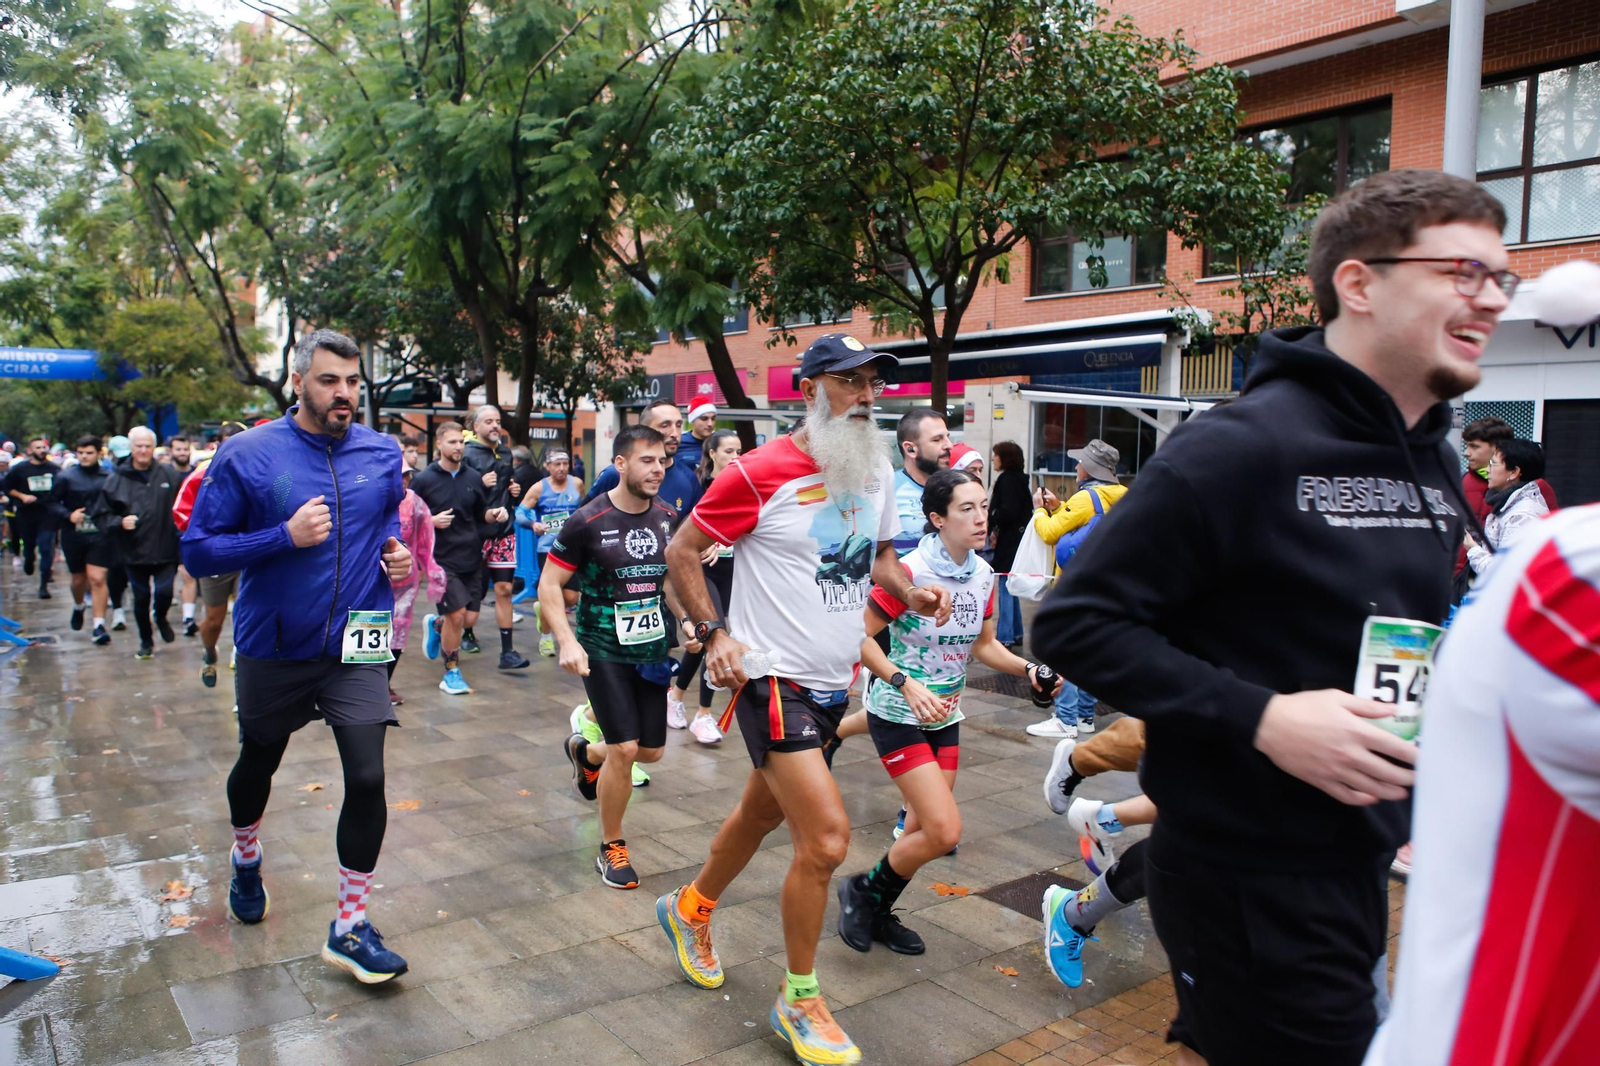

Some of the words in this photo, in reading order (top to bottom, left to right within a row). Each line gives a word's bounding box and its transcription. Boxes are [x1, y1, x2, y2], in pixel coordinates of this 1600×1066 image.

[1551, 322, 1600, 350] VI
[1084, 351, 1134, 368] QUERENCIA
[0, 363, 50, 374] CIRAS
[630, 538, 653, 548] TRAIL
[626, 582, 656, 594] VALTRA
[819, 580, 845, 606] Vive
[846, 577, 857, 604] la
[957, 603, 975, 613] TRAIL
[621, 611, 660, 633] 748
[350, 629, 389, 649] 131
[938, 633, 981, 646] FEND
